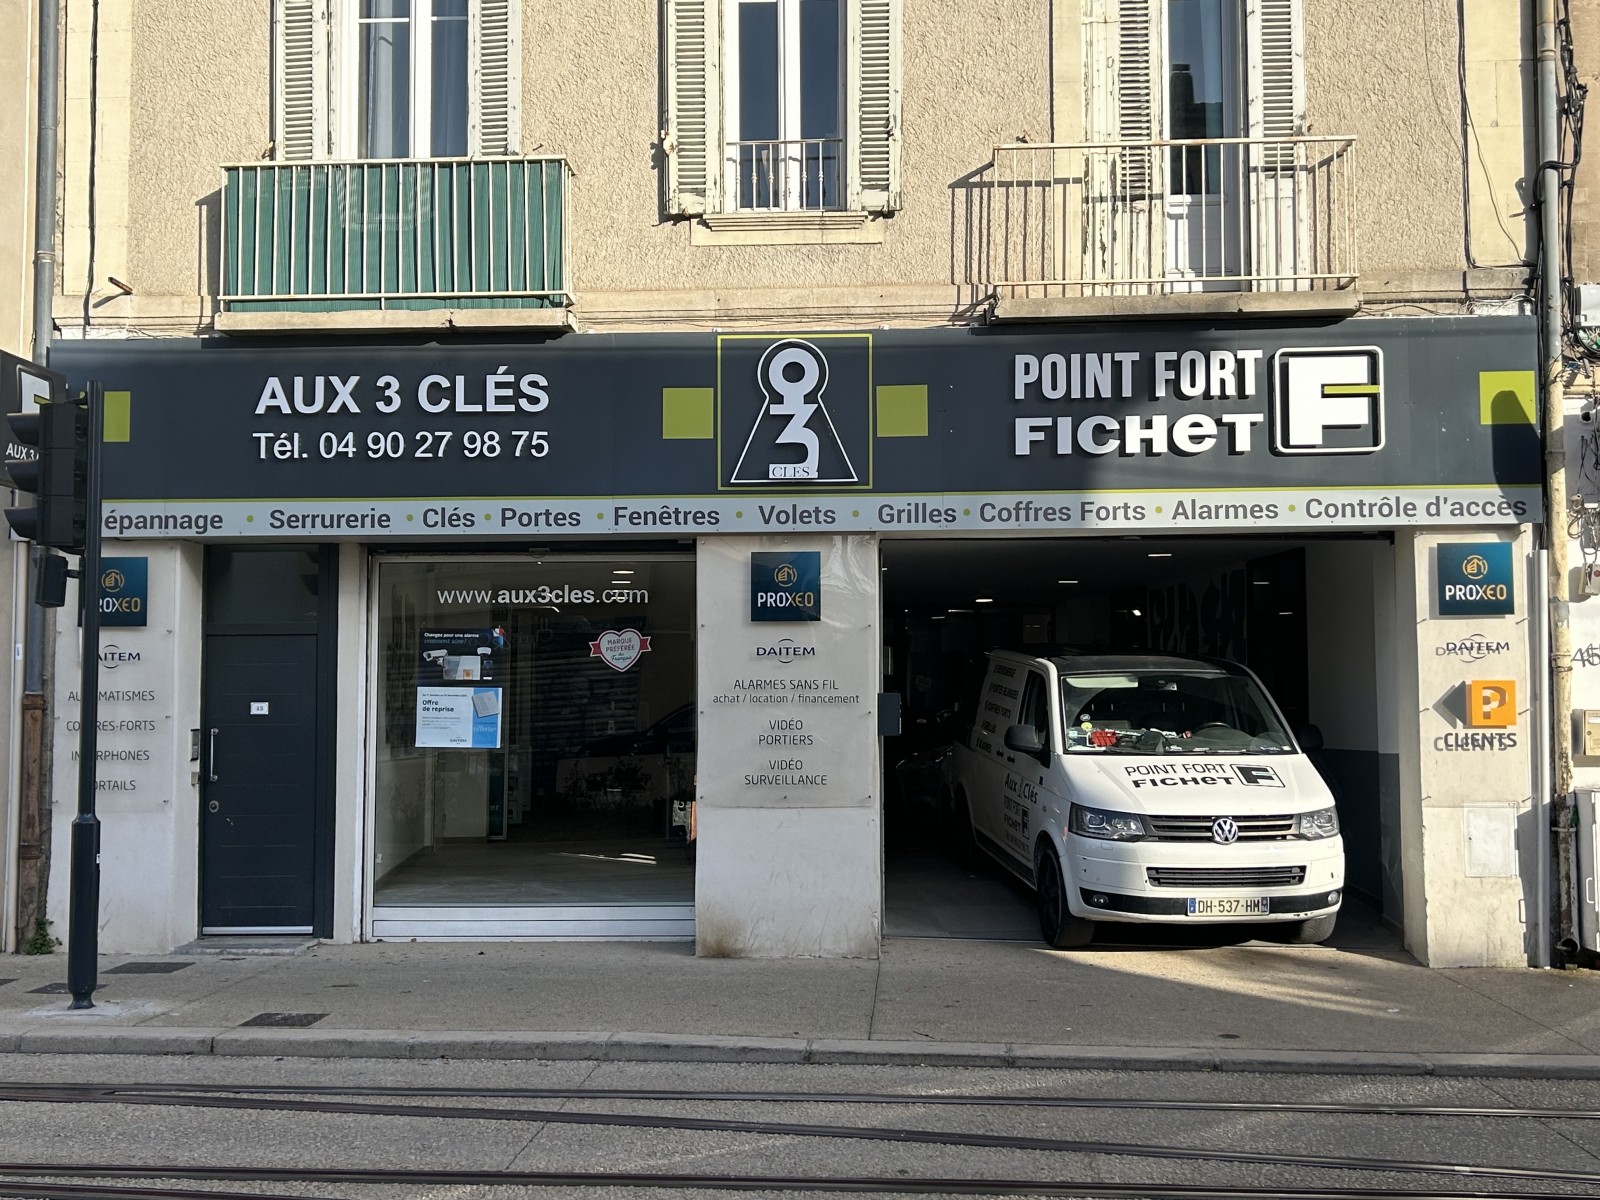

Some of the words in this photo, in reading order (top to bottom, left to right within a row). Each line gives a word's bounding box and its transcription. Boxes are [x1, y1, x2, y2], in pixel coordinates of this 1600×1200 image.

[1014, 352, 1140, 399] POINT
[1155, 349, 1263, 397] FORT
[255, 375, 361, 414] AUX
[376, 374, 401, 413] 3
[417, 366, 549, 413] CLÉS
[253, 432, 307, 459] Tél.
[319, 431, 356, 458] 04
[367, 431, 403, 458] 90
[415, 431, 453, 458] 27
[463, 431, 500, 458] 98
[512, 430, 549, 457] 75
[6, 442, 27, 461] AUX
[103, 509, 223, 534] épannage
[269, 509, 390, 531] Serrurerie
[423, 506, 475, 529] Clés
[501, 507, 581, 529] Portes
[614, 505, 720, 527] Fenêtres
[758, 504, 836, 526] Volets
[878, 503, 956, 525] Grilles
[979, 501, 1074, 524] Coffres
[1080, 500, 1146, 522] Forts
[1172, 498, 1279, 521] Alarmes
[1305, 496, 1417, 519] Contrôle
[1425, 493, 1528, 517] d'accès
[437, 585, 649, 604] www.aux3cles.com
[1445, 584, 1507, 600] PROXEO
[99, 597, 141, 612] OXEO
[757, 592, 815, 607] PROXEO
[607, 637, 633, 646] MARQUE
[1446, 641, 1510, 651] DAITEM
[97, 652, 141, 662] AITEM
[756, 647, 815, 656] DAITEM
[734, 679, 786, 690] ALARMES
[789, 679, 819, 690] SANS
[822, 679, 838, 690] FIL
[68, 690, 155, 701] AUMATISMES
[713, 694, 740, 703] achat
[749, 694, 788, 703] location
[798, 694, 860, 703] financement
[66, 720, 155, 731] CORES-FORTS
[769, 718, 803, 730] VIDÉO
[758, 735, 813, 745] PORTIERS
[1444, 733, 1517, 747] CLIENTS
[71, 750, 150, 760] INRPHONES
[769, 758, 803, 770] VIDÉO
[1124, 764, 1178, 776] POINT
[1181, 763, 1227, 773] FORT
[93, 780, 136, 790] ORTAILS
[744, 775, 828, 785] SURVEILLANCE
[1198, 899, 1260, 913] DH-537-HM
